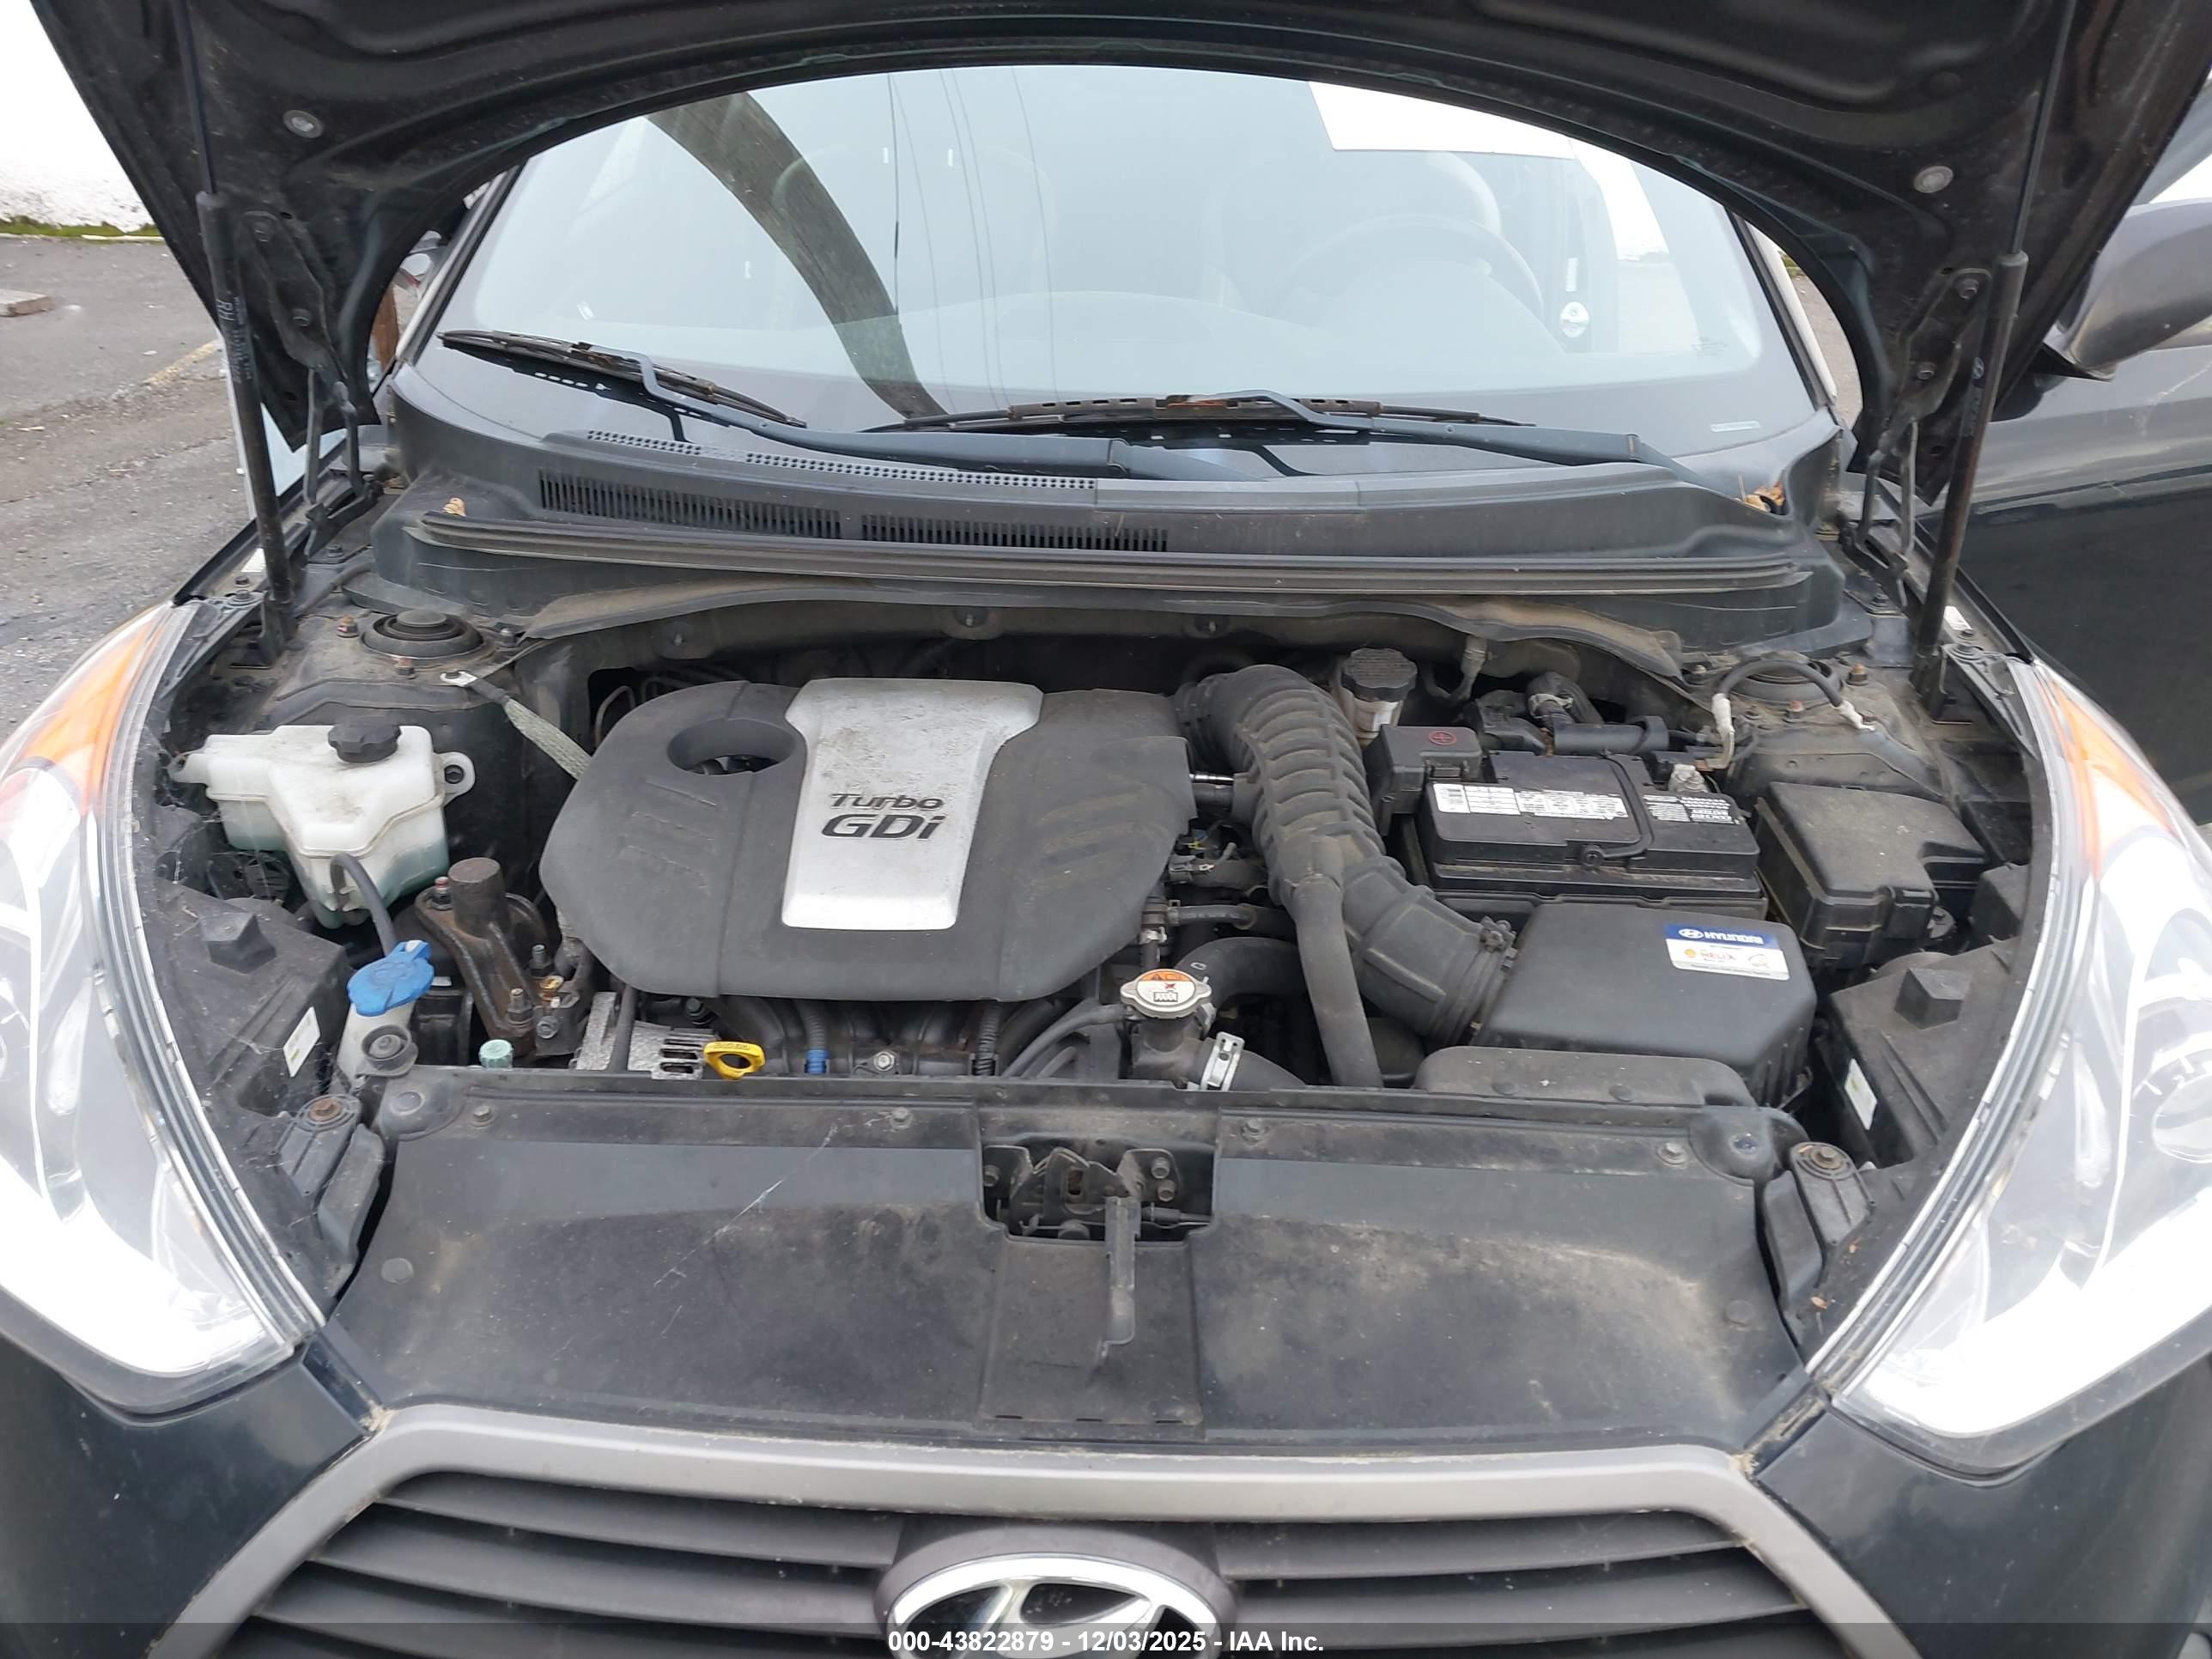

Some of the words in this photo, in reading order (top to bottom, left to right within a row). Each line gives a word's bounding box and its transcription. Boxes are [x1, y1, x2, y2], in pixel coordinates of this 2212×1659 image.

[831, 792, 945, 811] Turbo
[822, 813, 946, 839] GDi
[1704, 931, 1764, 945] HYUNDAI
